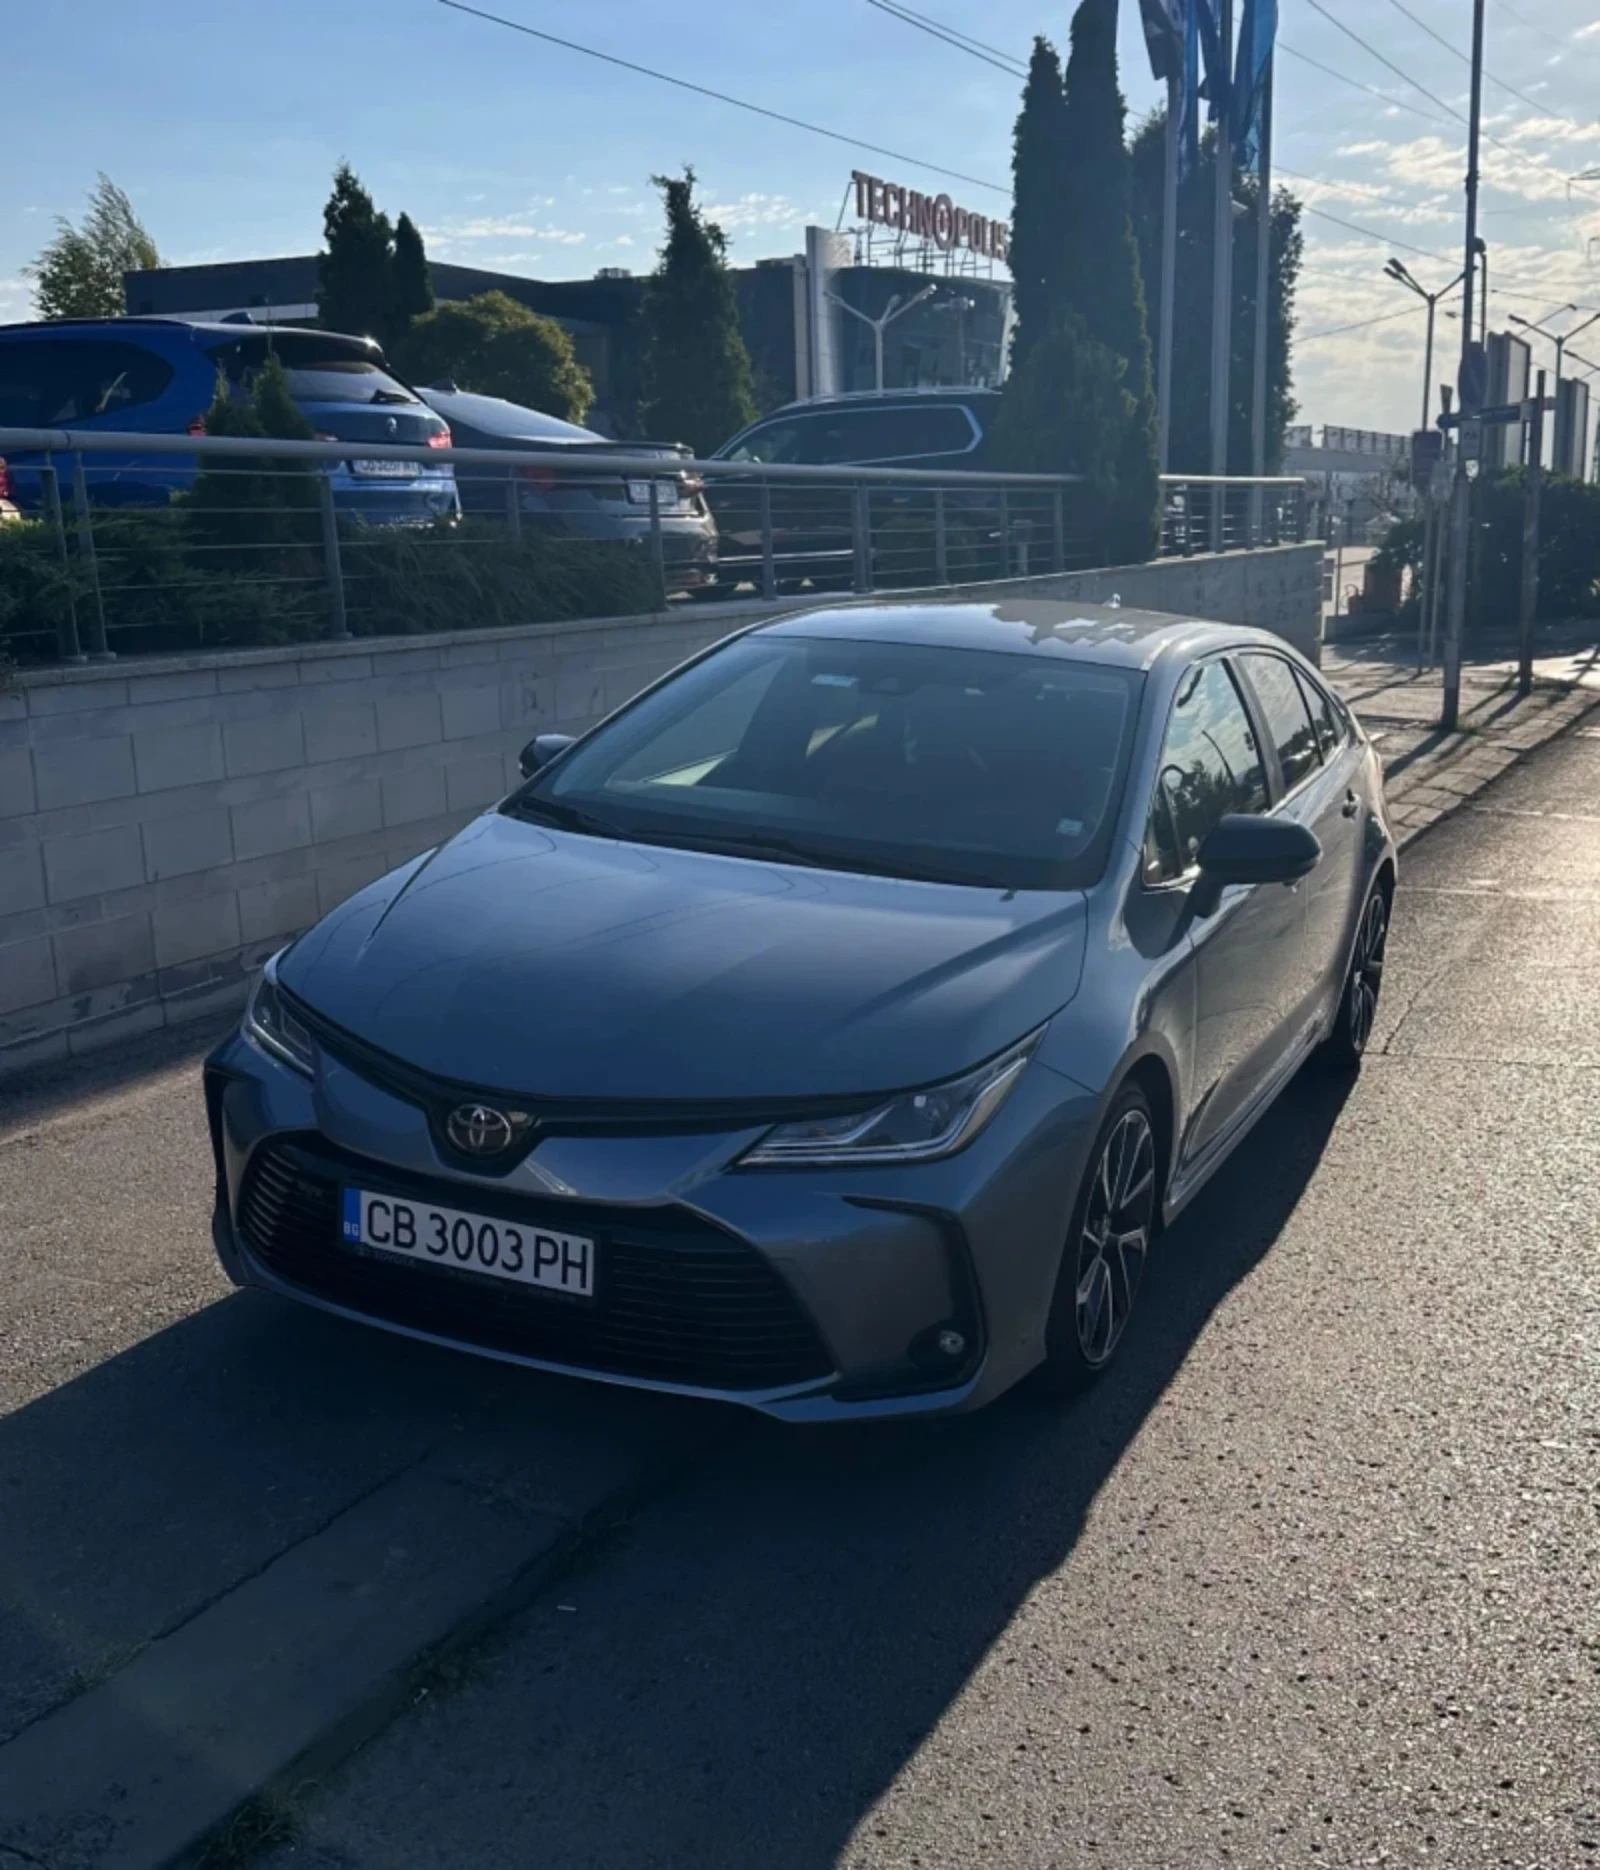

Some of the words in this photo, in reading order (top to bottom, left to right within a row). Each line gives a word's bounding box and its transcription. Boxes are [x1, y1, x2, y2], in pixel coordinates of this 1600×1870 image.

[852, 169, 1010, 261] TECHNOPOLIS
[344, 1221, 359, 1236] BG
[367, 1200, 417, 1250] CB
[426, 1213, 523, 1273] 3003
[533, 1235, 587, 1289] PH
